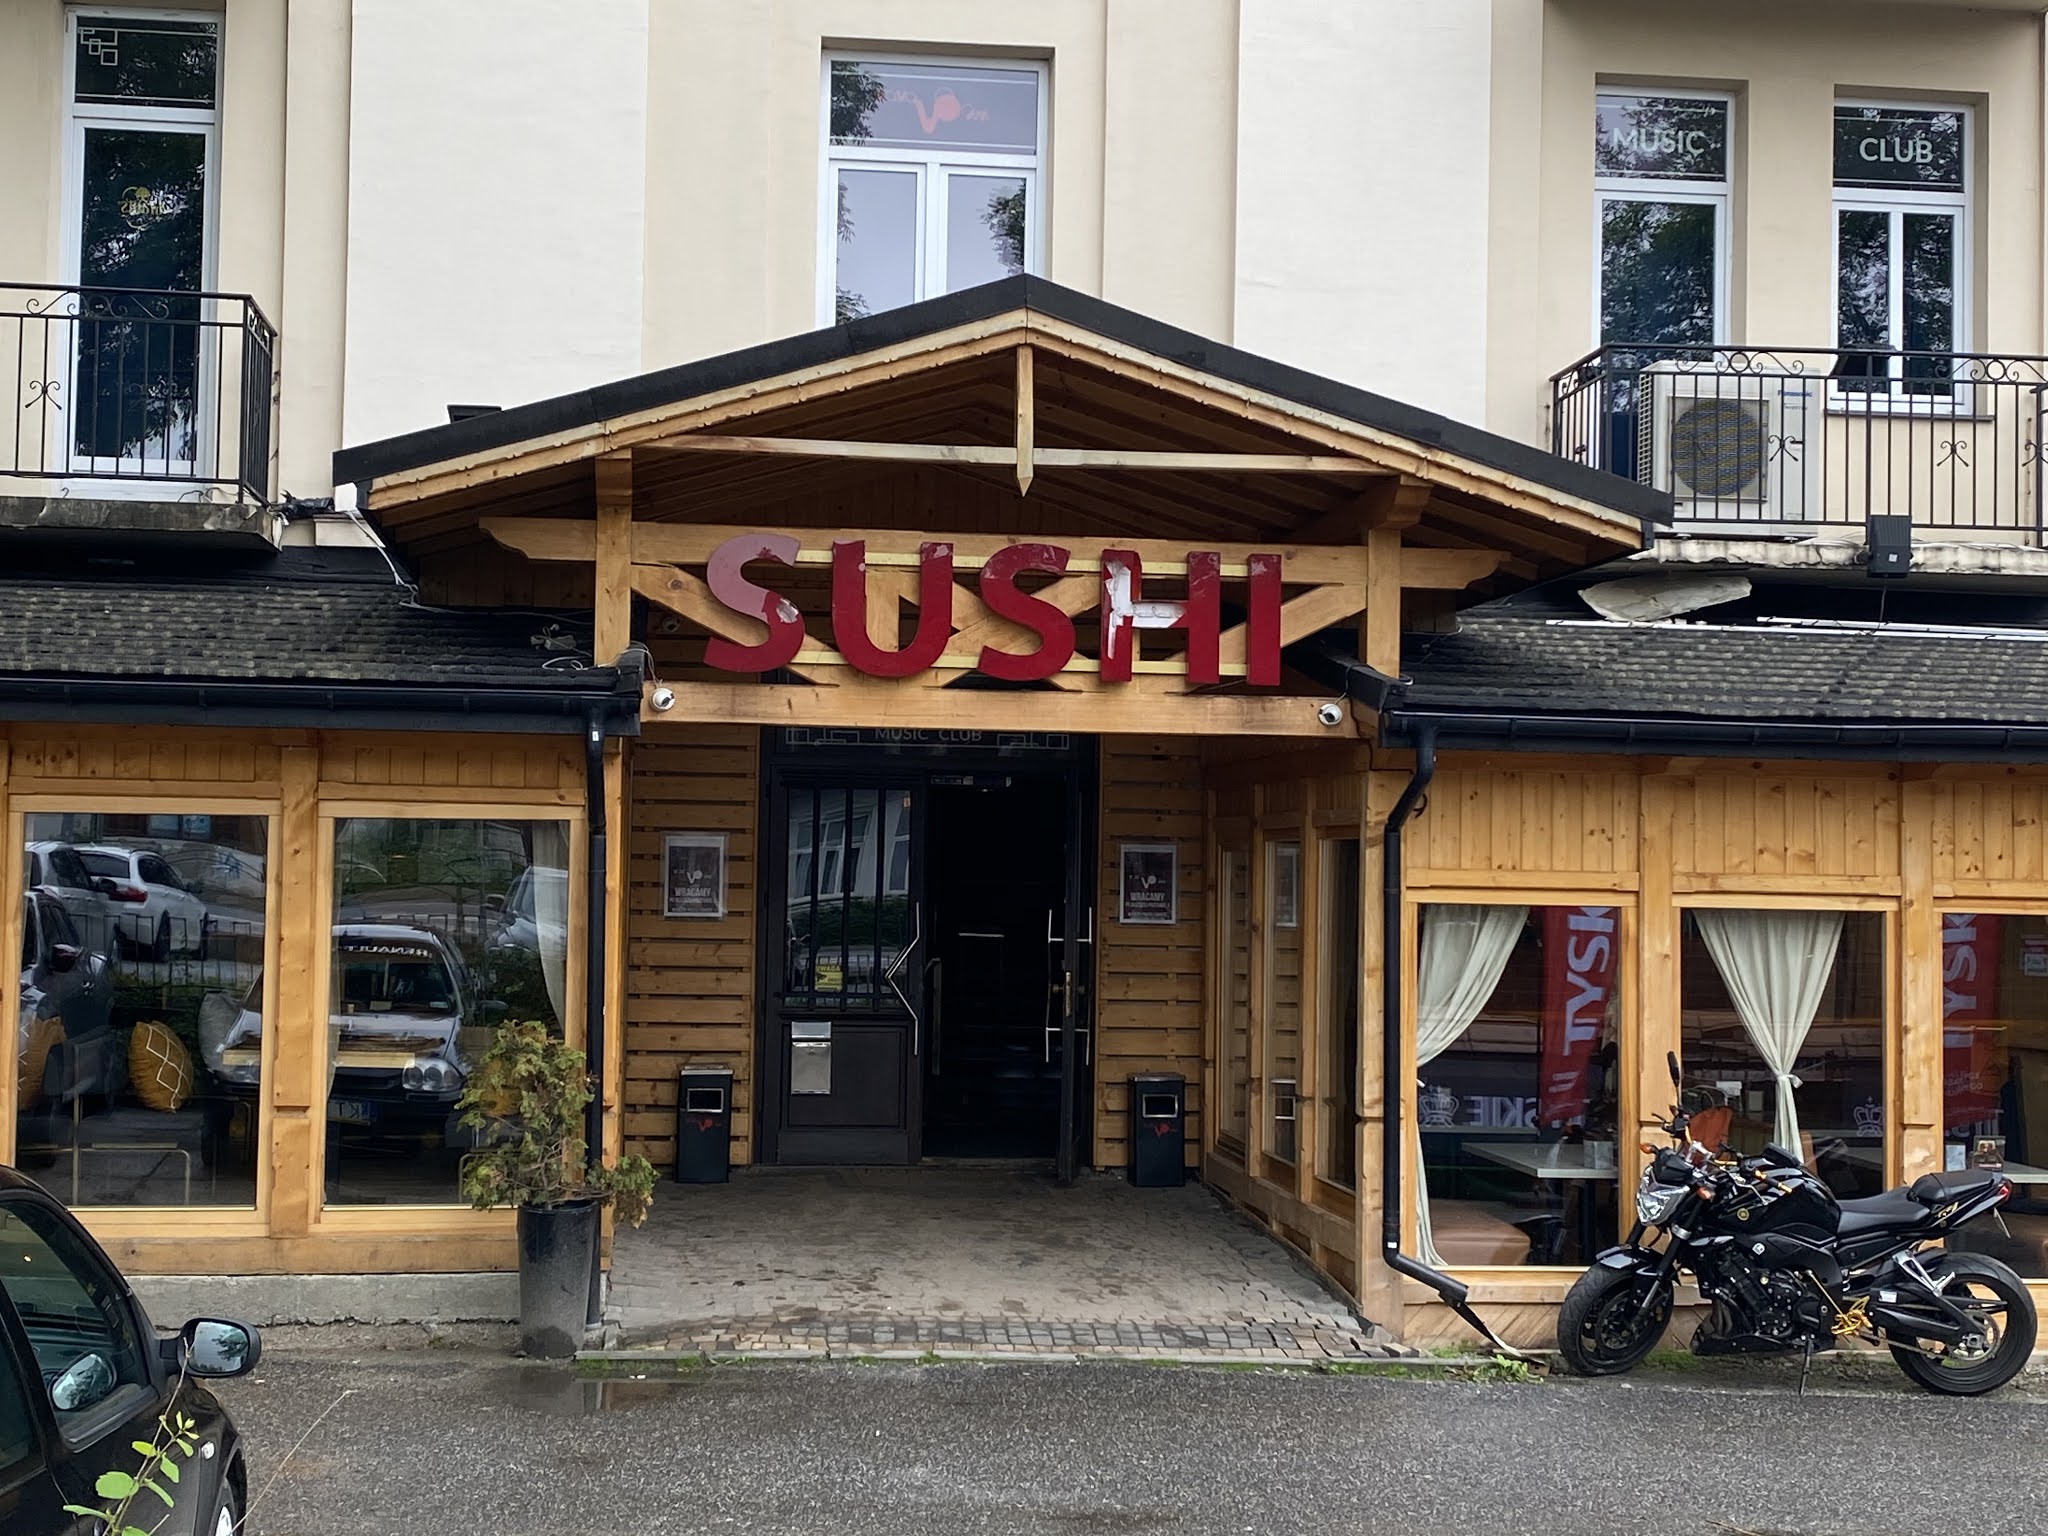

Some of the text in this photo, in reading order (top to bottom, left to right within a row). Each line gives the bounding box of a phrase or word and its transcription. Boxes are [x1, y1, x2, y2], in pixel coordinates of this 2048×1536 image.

[1611, 127, 1706, 157] MUSIC
[1860, 136, 1934, 164] CLUB
[704, 534, 1281, 686] SUSHI
[875, 728, 982, 742] MUSIC CLUB
